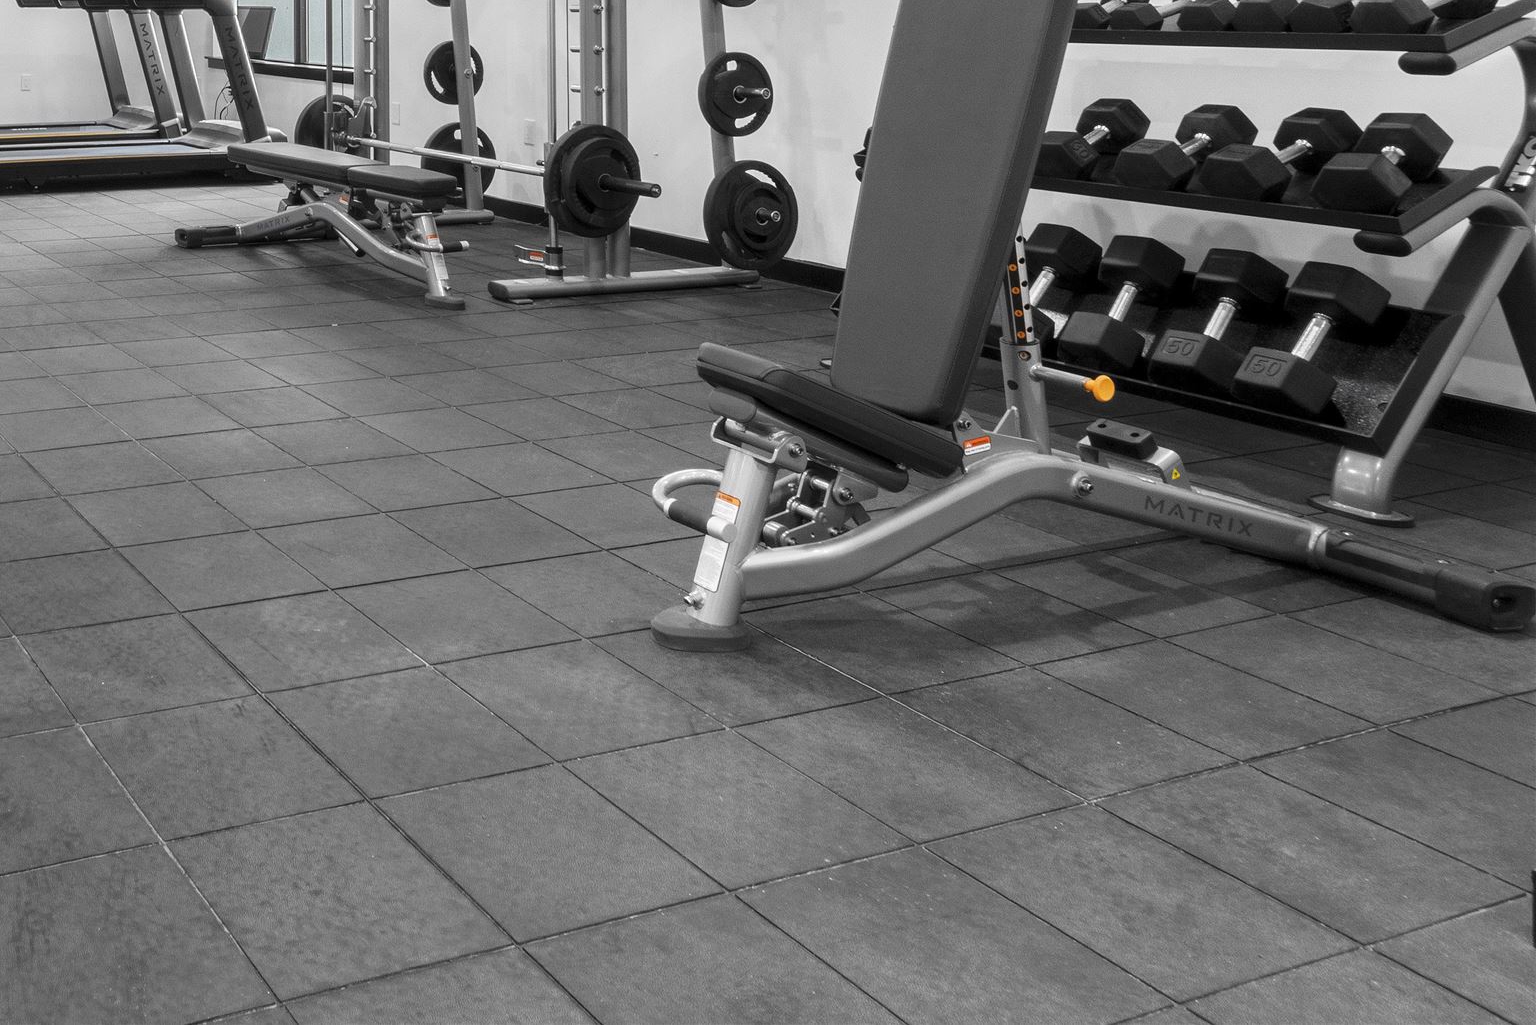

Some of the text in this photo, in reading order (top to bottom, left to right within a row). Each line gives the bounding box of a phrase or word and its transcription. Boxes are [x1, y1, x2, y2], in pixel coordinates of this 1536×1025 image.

[139, 22, 166, 95] MATRIX
[225, 26, 254, 111] MATRIX
[1164, 340, 1195, 356] 50
[1250, 359, 1282, 377] 50
[1145, 494, 1253, 537] MATRIX
